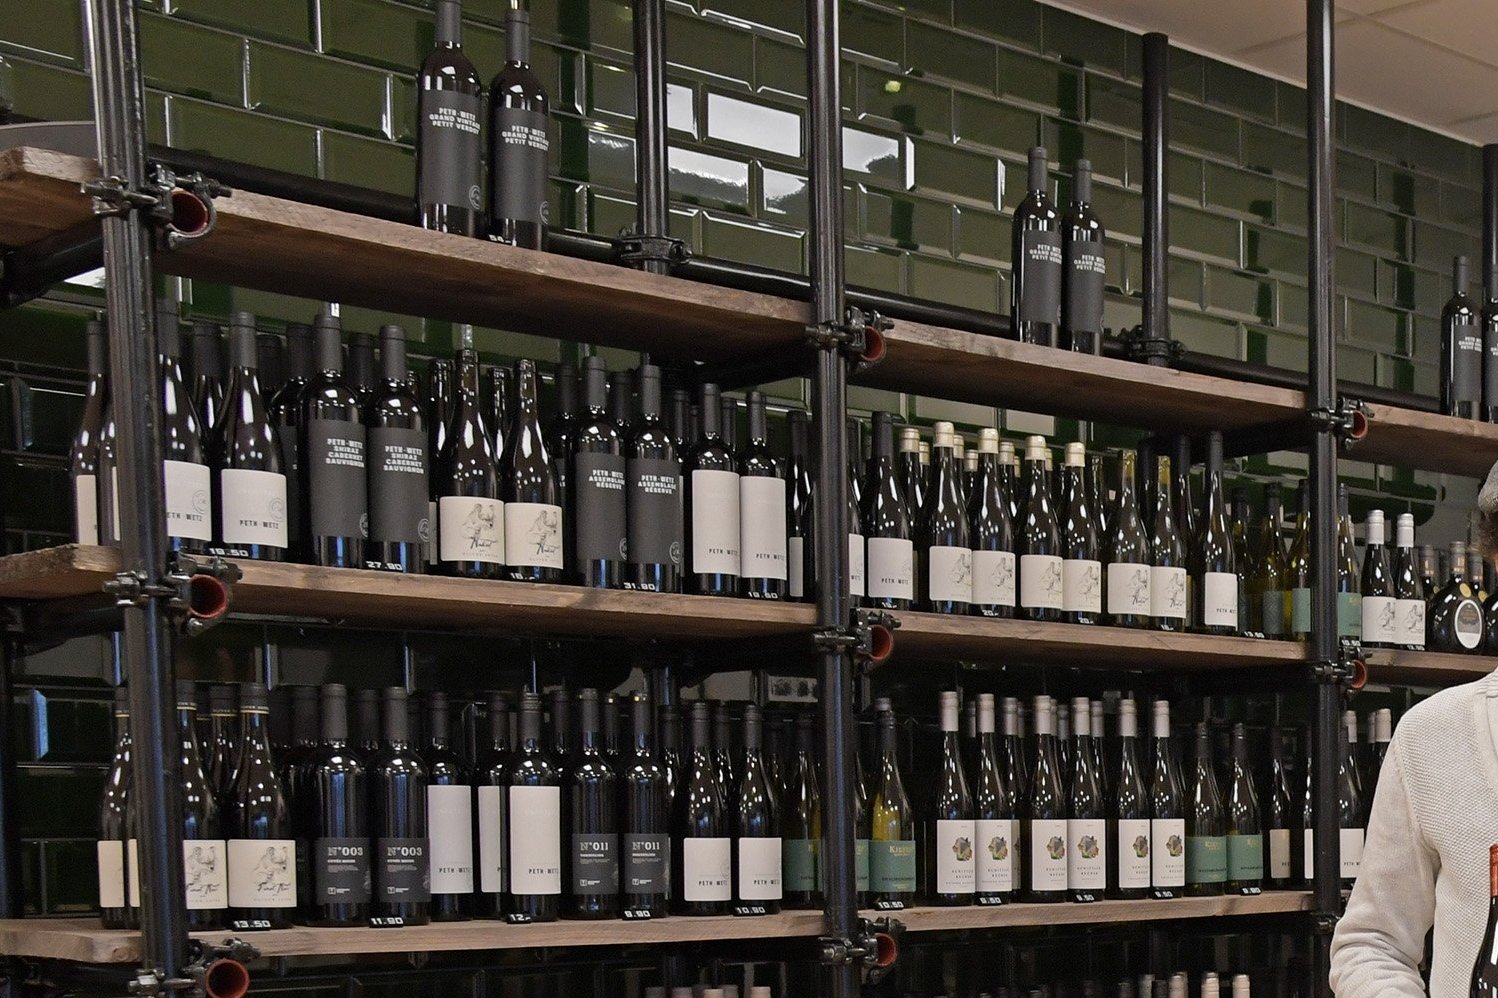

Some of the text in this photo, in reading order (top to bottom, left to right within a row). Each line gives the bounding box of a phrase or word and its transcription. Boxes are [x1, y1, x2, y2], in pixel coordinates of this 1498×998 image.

[333, 445, 360, 454] SHIRAZ
[328, 451, 364, 462] CABERNET
[391, 452, 418, 461] SHIRAZ
[325, 457, 365, 468] SAUVIGNON
[386, 458, 423, 468] CABERNET
[384, 465, 425, 475] SAUVIGNON
[644, 485, 673, 495] RÉSERVE
[233, 919, 271, 929] 13.50
